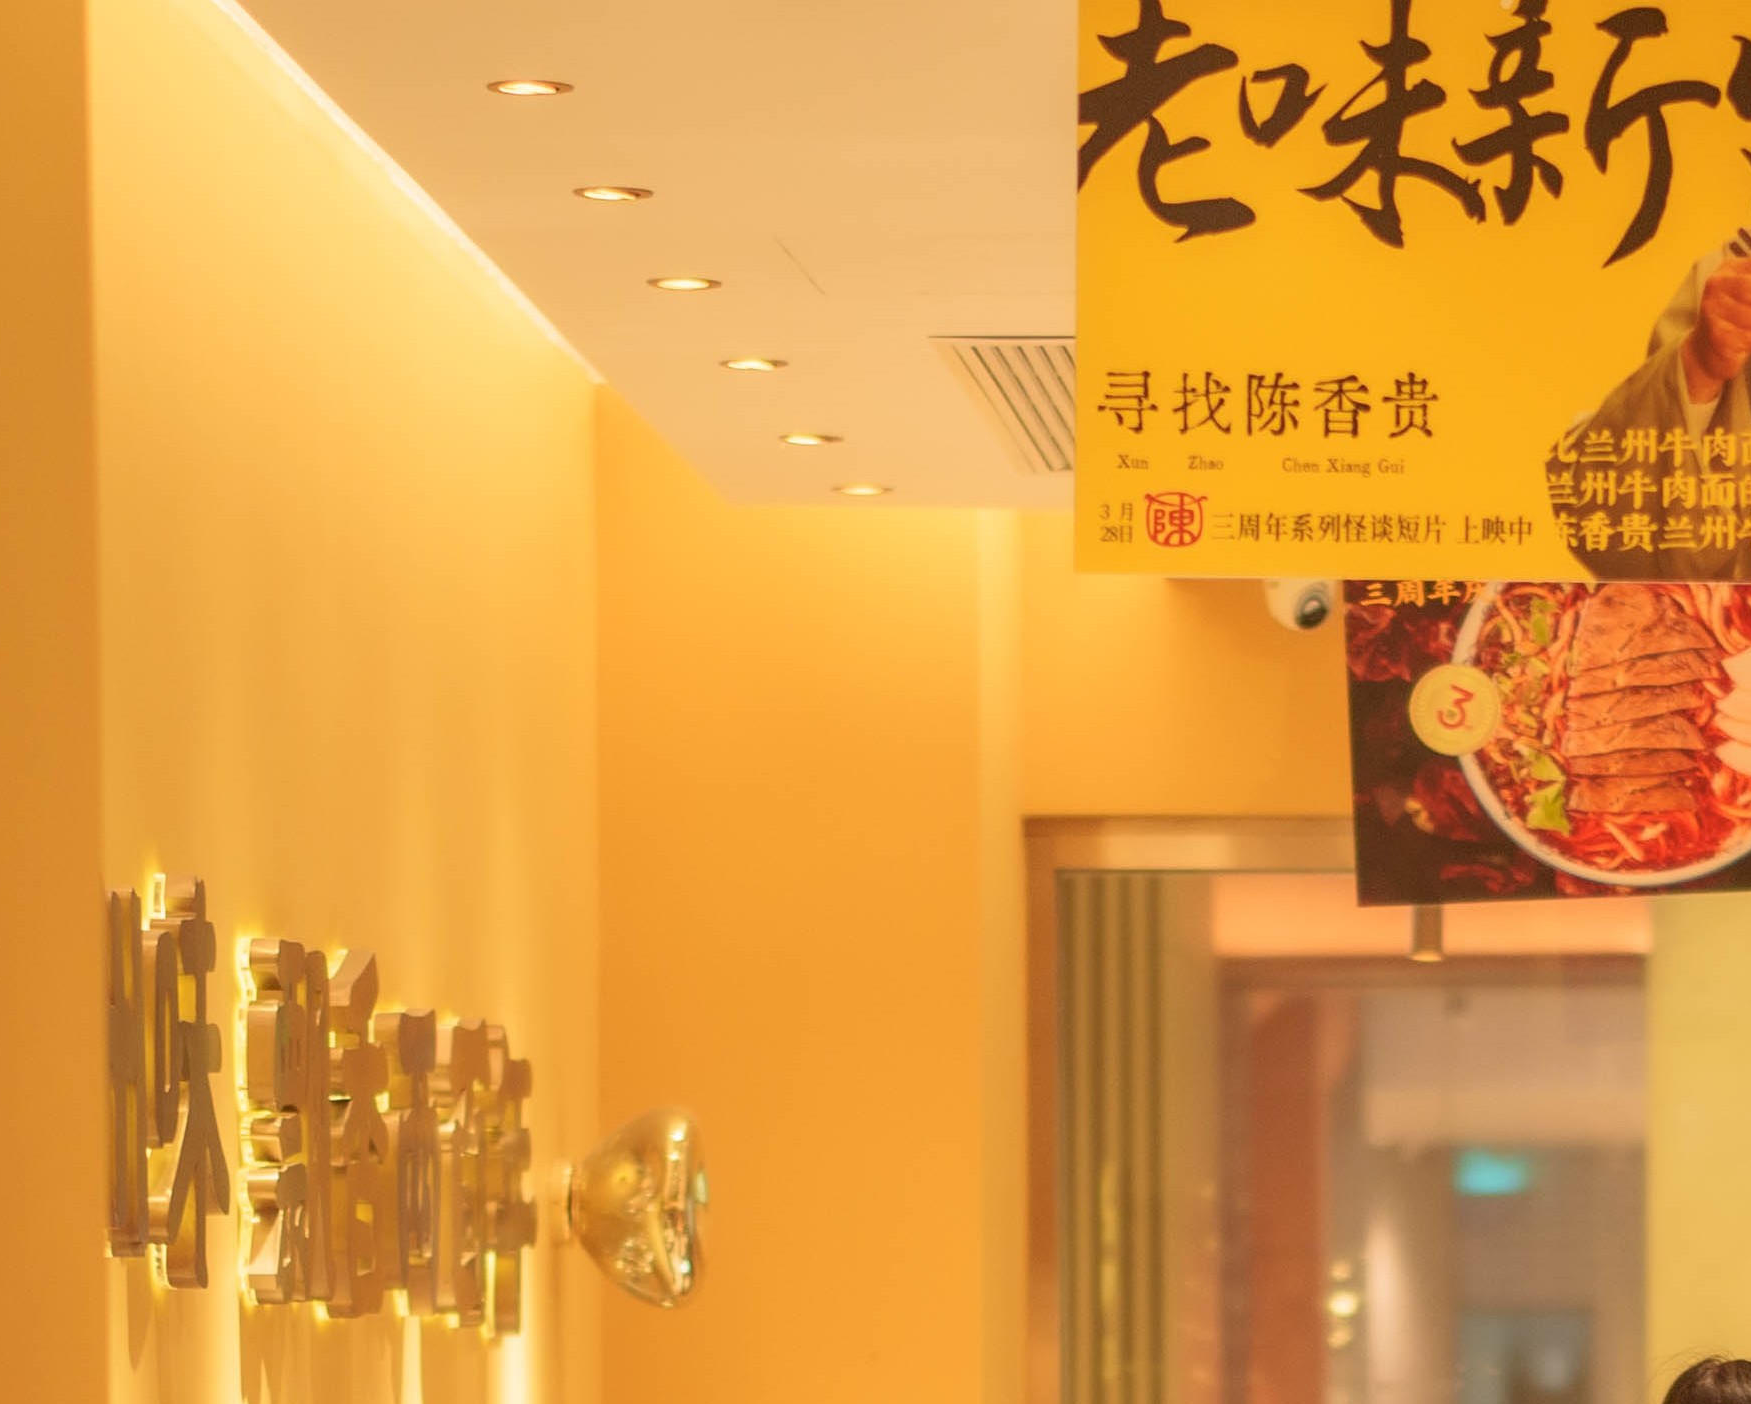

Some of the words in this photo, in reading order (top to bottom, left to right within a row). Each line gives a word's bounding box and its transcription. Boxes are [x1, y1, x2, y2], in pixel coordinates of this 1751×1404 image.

[1098, 370, 1439, 438] 寻找陈香贵
[1116, 454, 1150, 470] Xun
[1187, 454, 1224, 470] Zhao
[1281, 456, 1320, 473] Chen
[1325, 456, 1371, 477] Xiang
[1377, 456, 1406, 474] Gui
[1099, 525, 1134, 543] 28日
[1213, 512, 1447, 545] 三周年系列怪谈短片
[1457, 515, 1533, 545] 上映中
